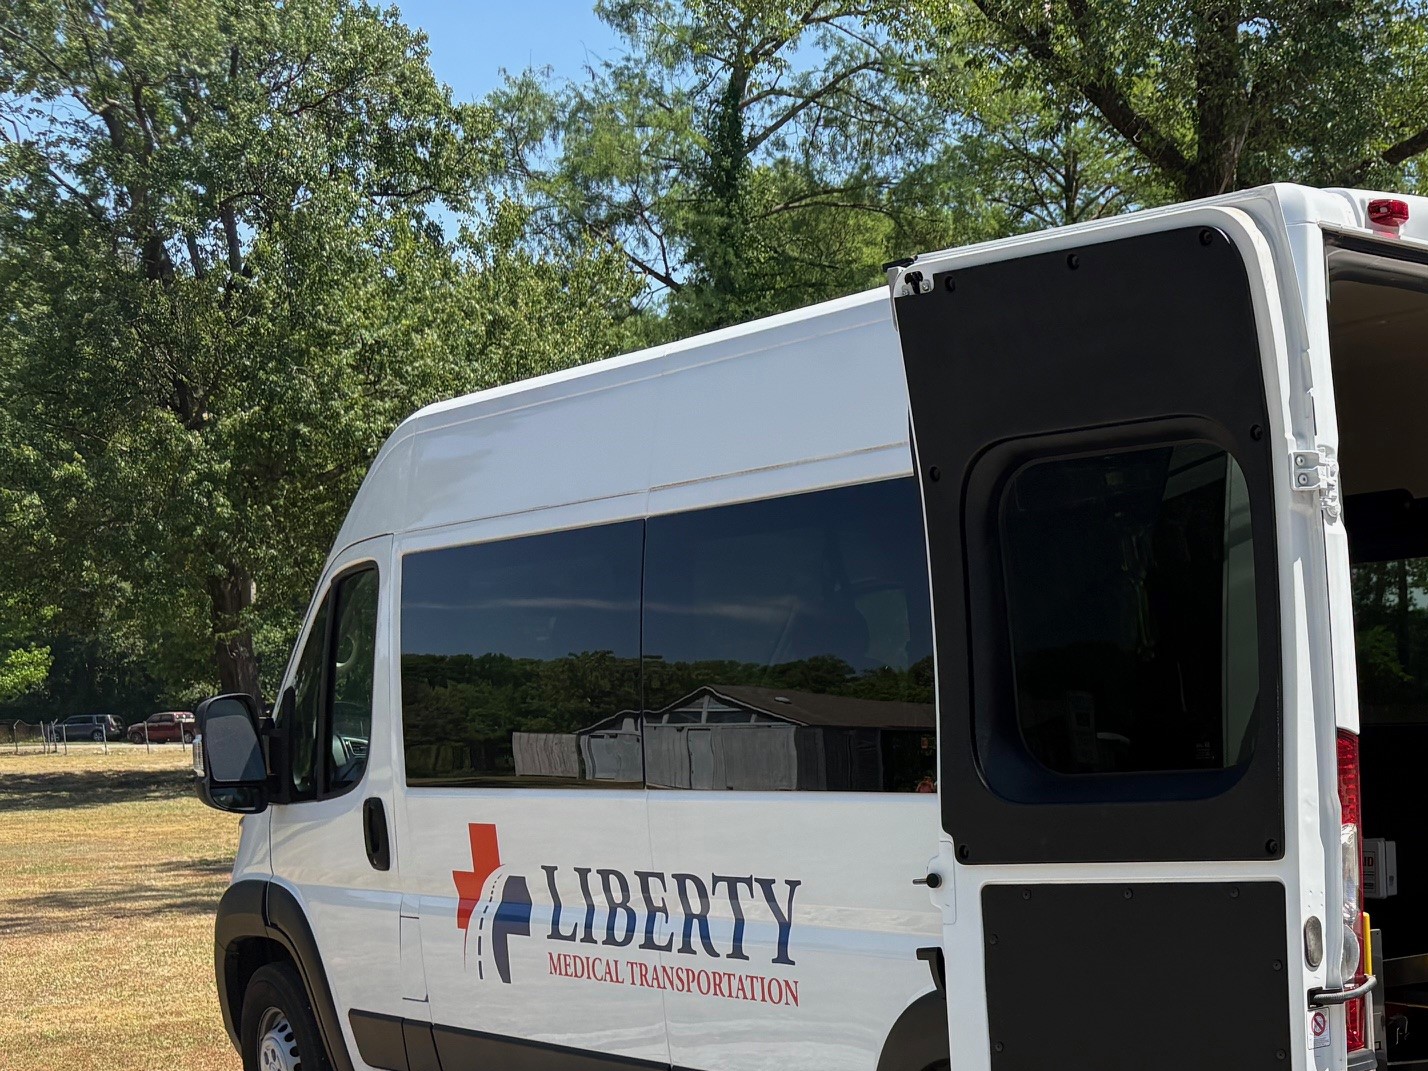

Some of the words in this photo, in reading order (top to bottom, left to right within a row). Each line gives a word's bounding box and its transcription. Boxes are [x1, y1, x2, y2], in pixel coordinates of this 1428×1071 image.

[541, 865, 802, 966] LIBERTY
[547, 951, 625, 986] MEDICAL
[626, 960, 800, 1008] TRANSPORTATION
